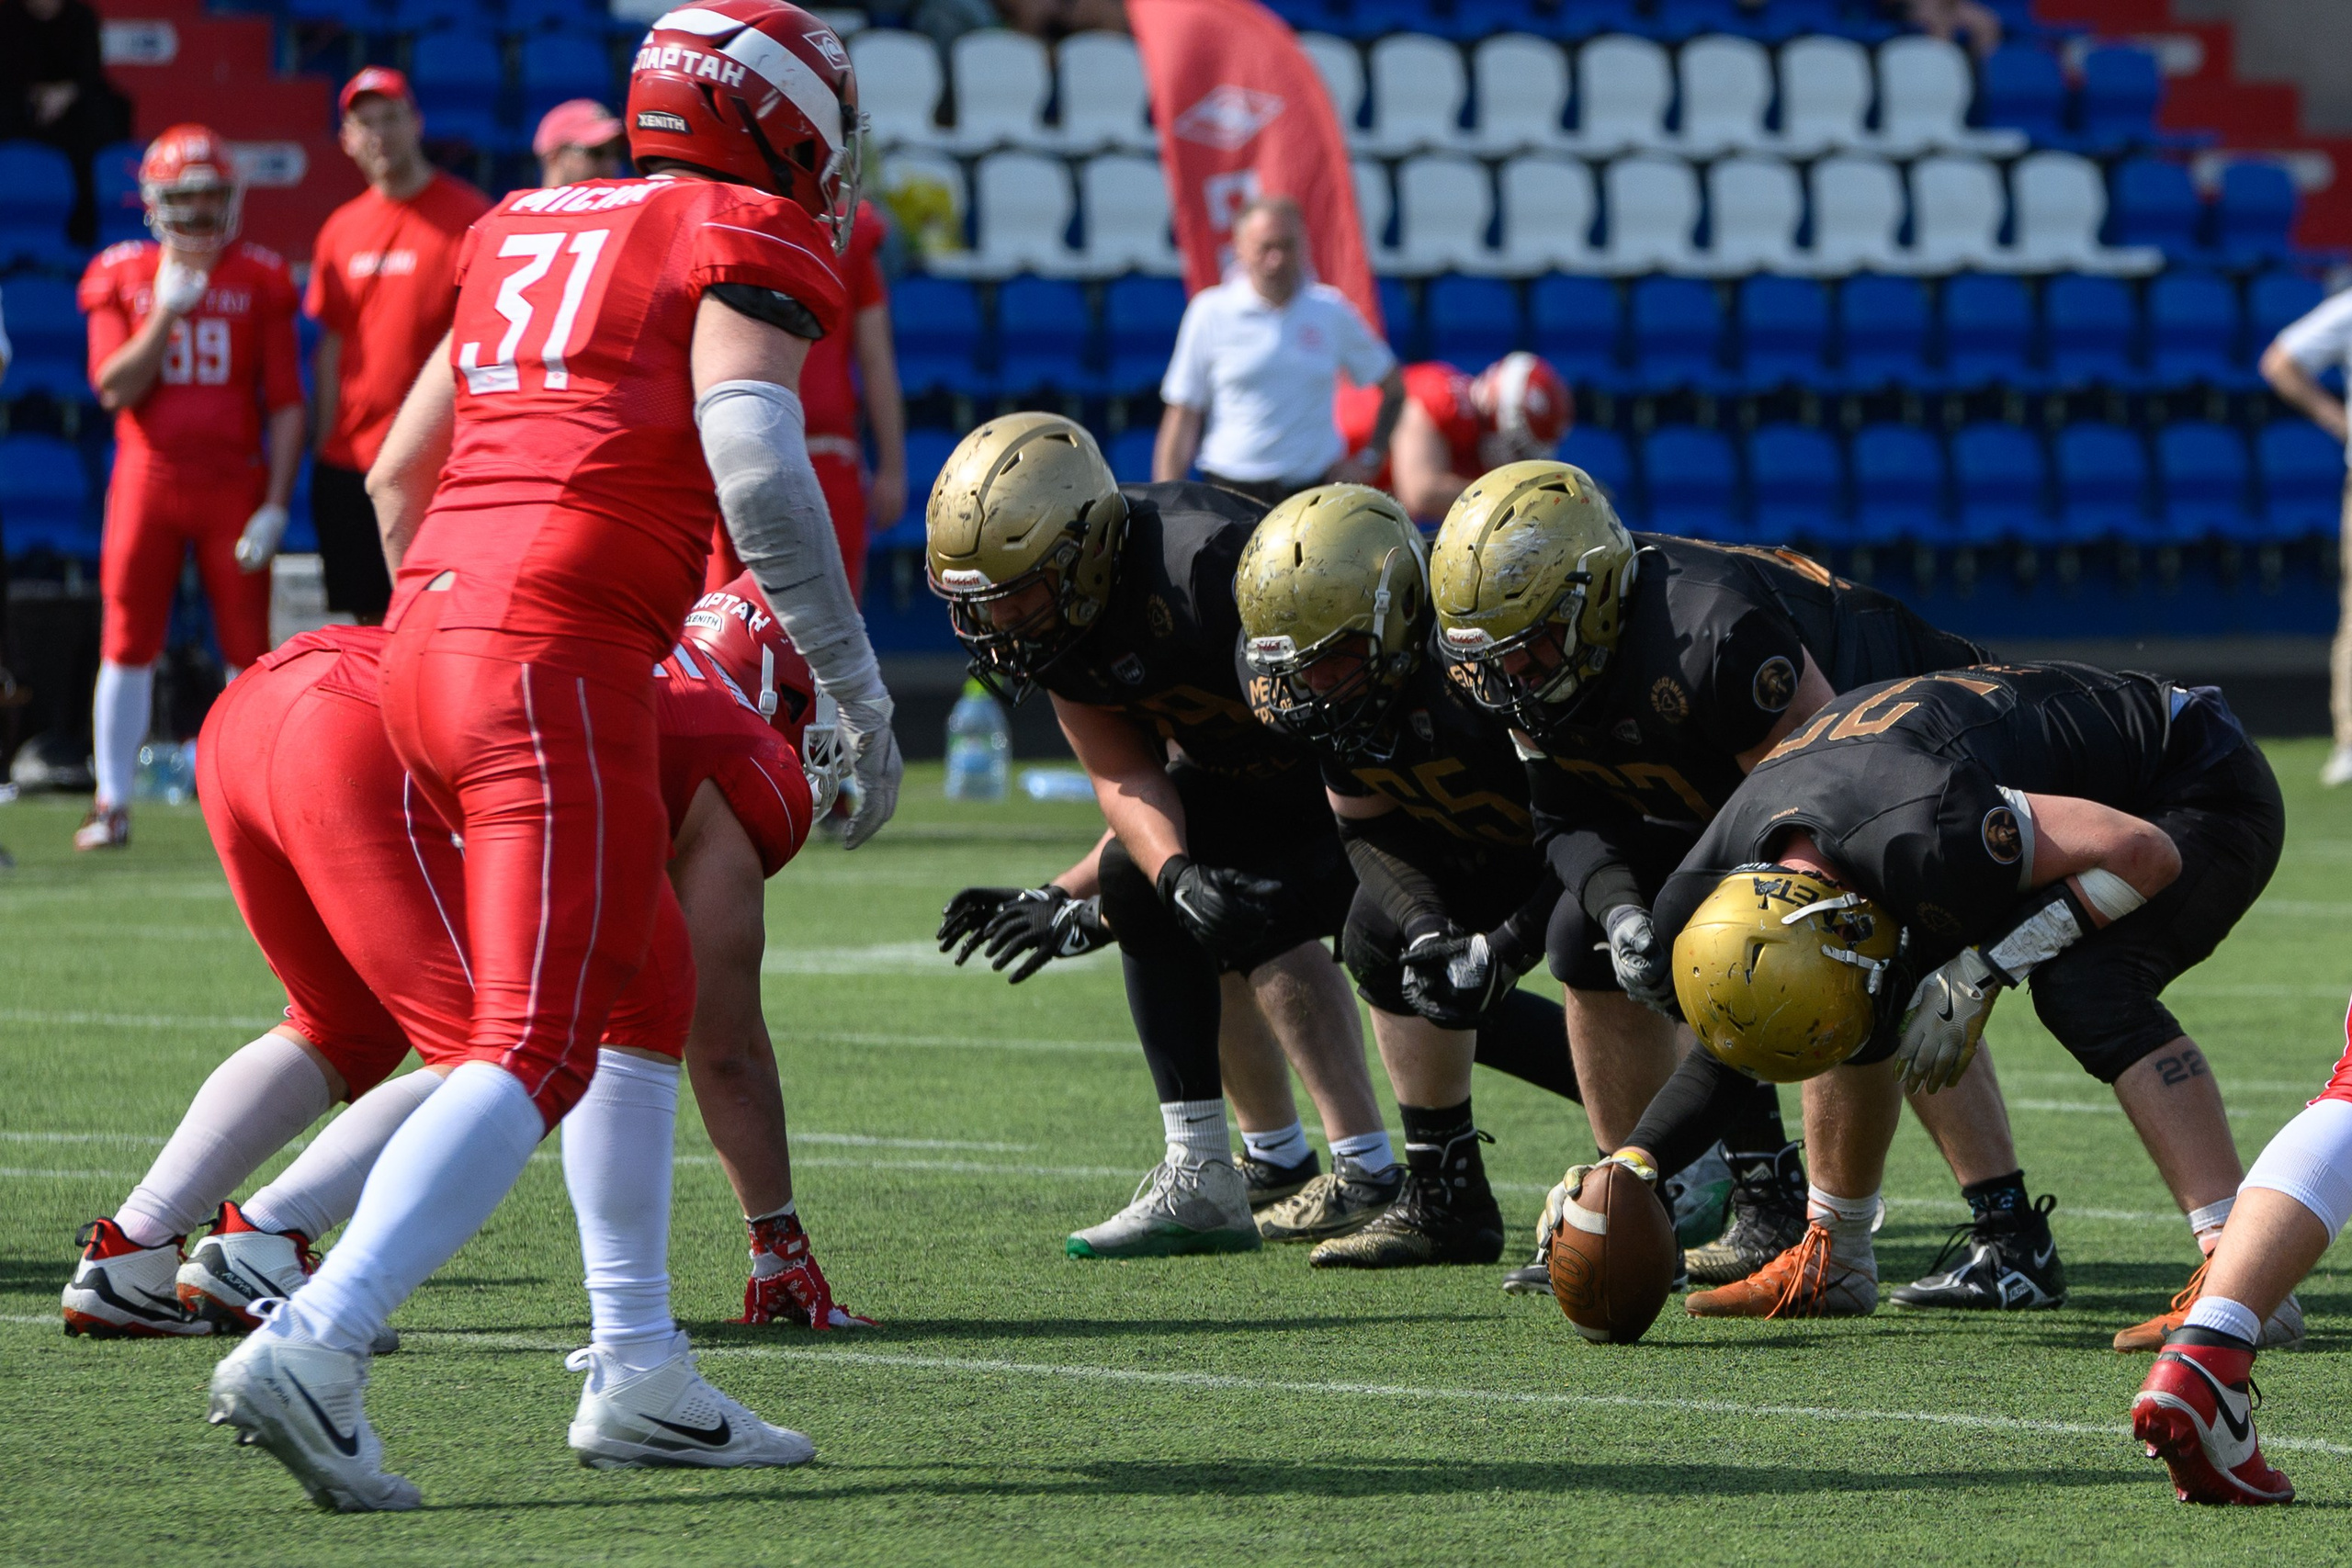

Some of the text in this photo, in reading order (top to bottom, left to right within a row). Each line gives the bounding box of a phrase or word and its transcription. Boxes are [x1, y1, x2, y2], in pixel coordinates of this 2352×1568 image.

[639, 113, 685, 131] XENITH
[458, 229, 610, 395] 31
[687, 615, 719, 626] XENITH
[2154, 1048, 2207, 1086] 22
[222, 1271, 254, 1297] ALPHA
